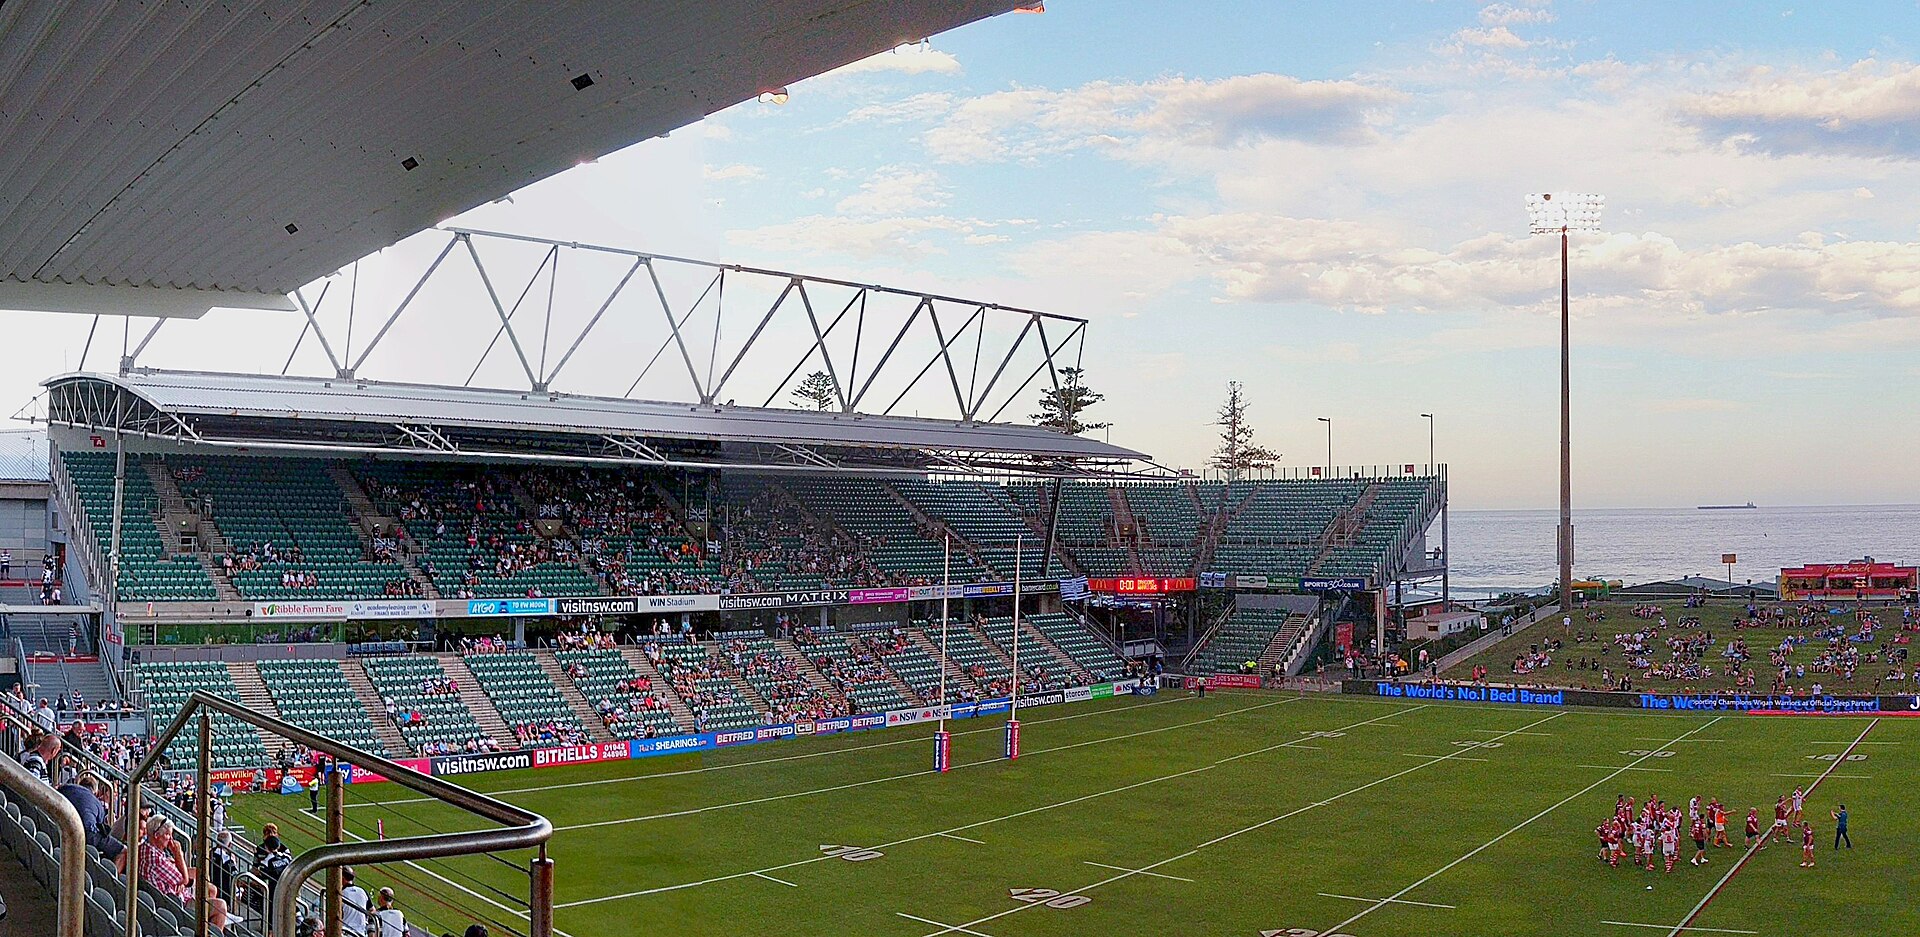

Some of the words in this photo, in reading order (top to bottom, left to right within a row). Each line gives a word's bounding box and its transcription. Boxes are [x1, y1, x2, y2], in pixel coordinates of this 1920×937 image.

[1841, 564, 1871, 572] Beach
[649, 598, 666, 606] WIN
[667, 597, 696, 606] Stadium
[720, 596, 782, 608] visitnsw.com
[786, 591, 848, 602] MATRIX
[275, 604, 301, 613] Ribble
[303, 604, 324, 613] Farm
[326, 604, 343, 613] Fare
[472, 602, 495, 613] AYGO
[561, 600, 634, 614] visitnsw.com
[1377, 683, 1401, 696] The
[1405, 684, 1454, 699] World's
[1458, 687, 1485, 700] No.1
[1490, 688, 1516, 702] Bed
[1520, 690, 1562, 704] Brand
[1640, 695, 1668, 709] The
[1718, 699, 1752, 707] Champions
[1833, 699, 1850, 708] Sleep
[852, 715, 884, 727] BETFRED
[899, 712, 918, 722] NSW
[817, 719, 849, 731] BETFRED
[716, 731, 754, 744] BETFRED
[757, 726, 793, 739] BETFRED
[536, 747, 598, 764] BITHELLS
[436, 755, 530, 775] visitnsw.com
[1010, 888, 1092, 909] 20
